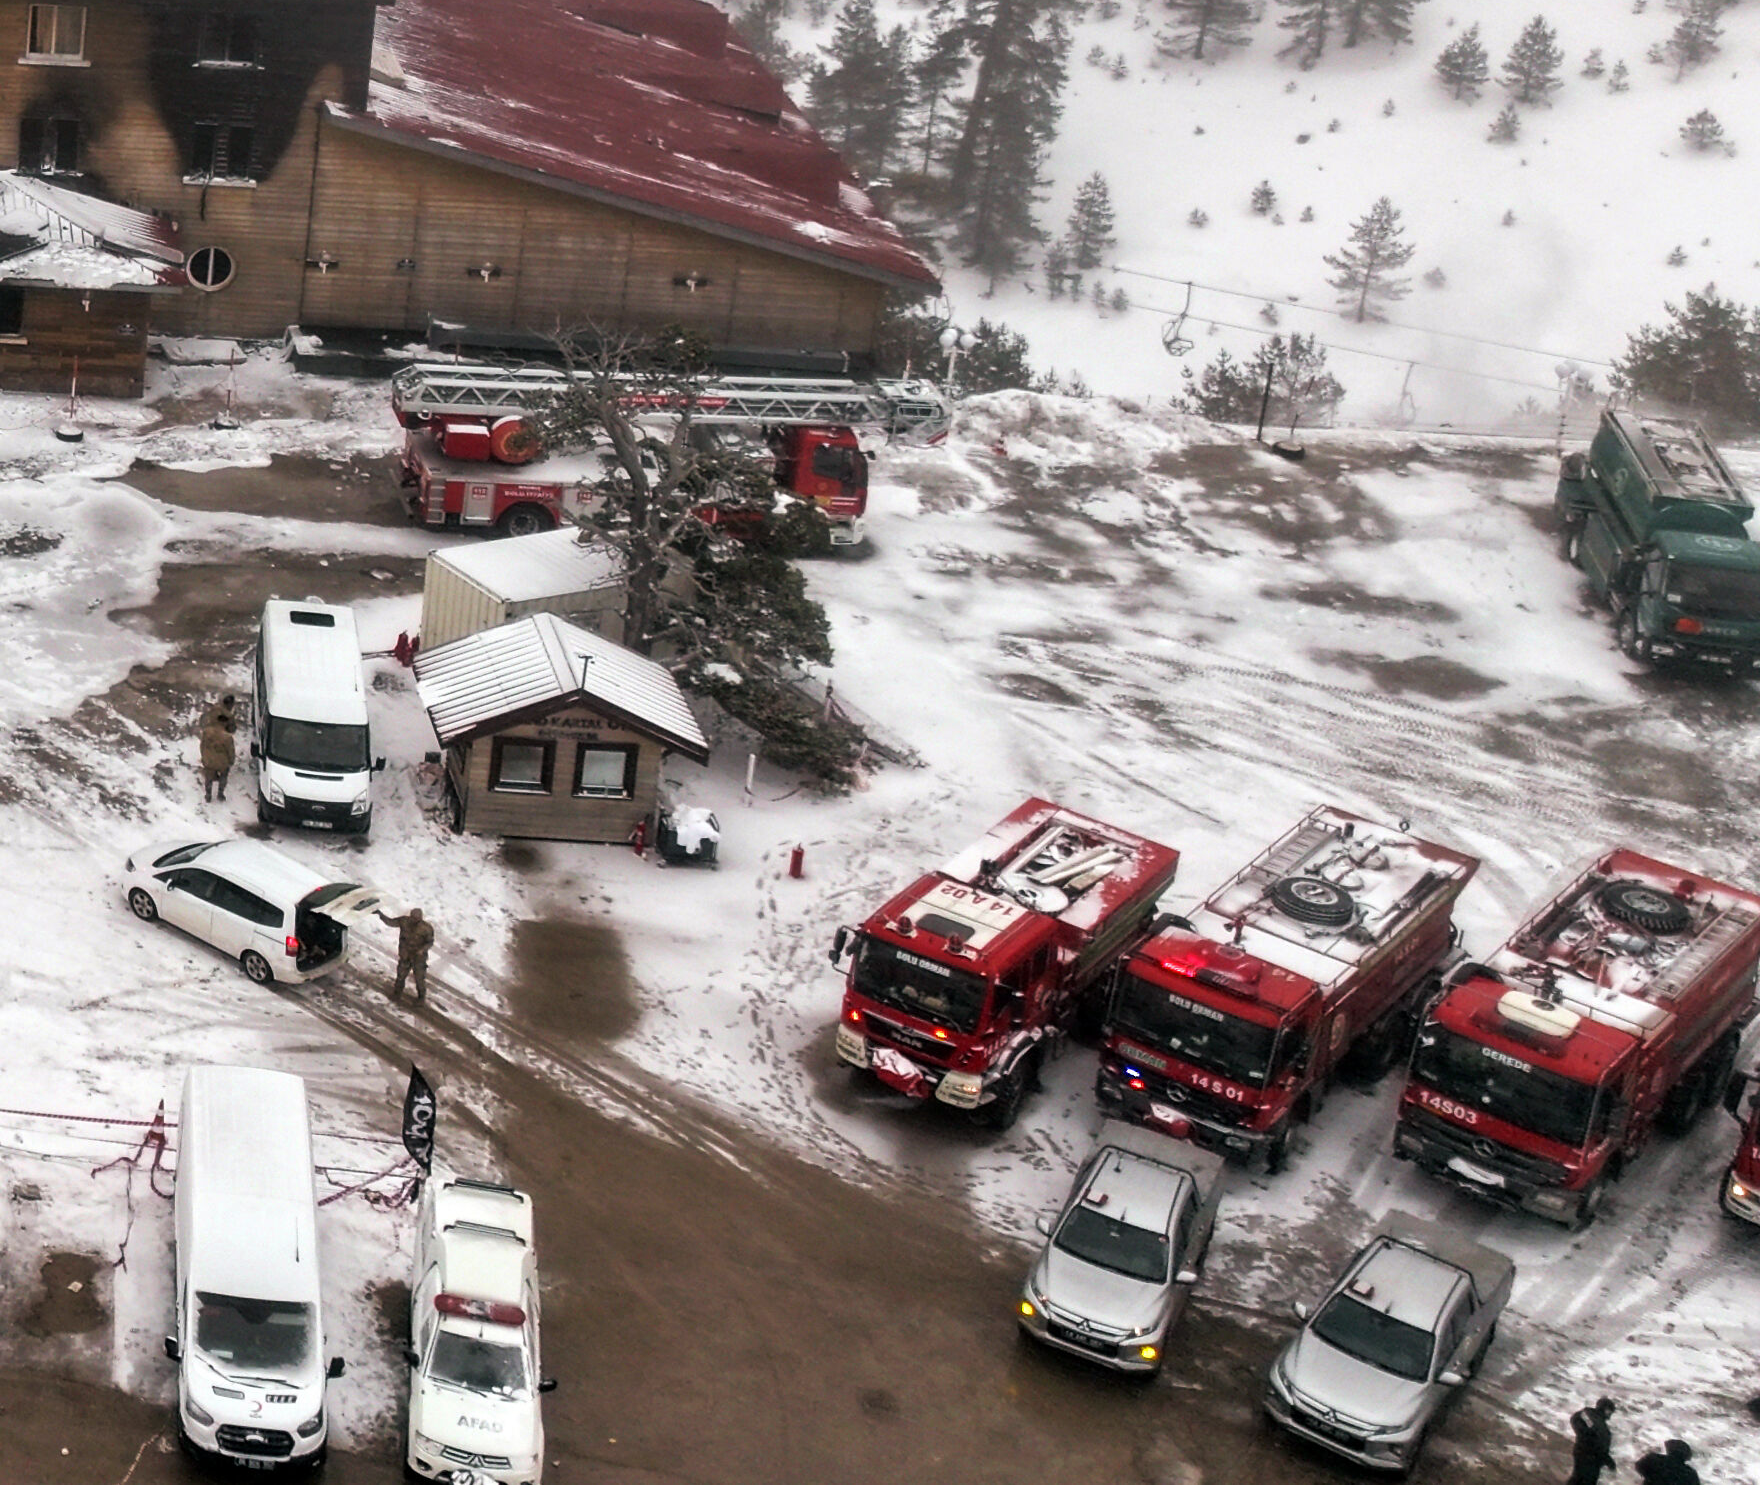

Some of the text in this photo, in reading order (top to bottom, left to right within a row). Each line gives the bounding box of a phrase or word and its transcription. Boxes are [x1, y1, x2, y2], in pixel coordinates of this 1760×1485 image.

[896, 950, 919, 966] BOLU
[1482, 1047, 1533, 1073] GEREDE
[1191, 1073, 1244, 1102] 14 S 01
[457, 1415, 503, 1433] AFAD
